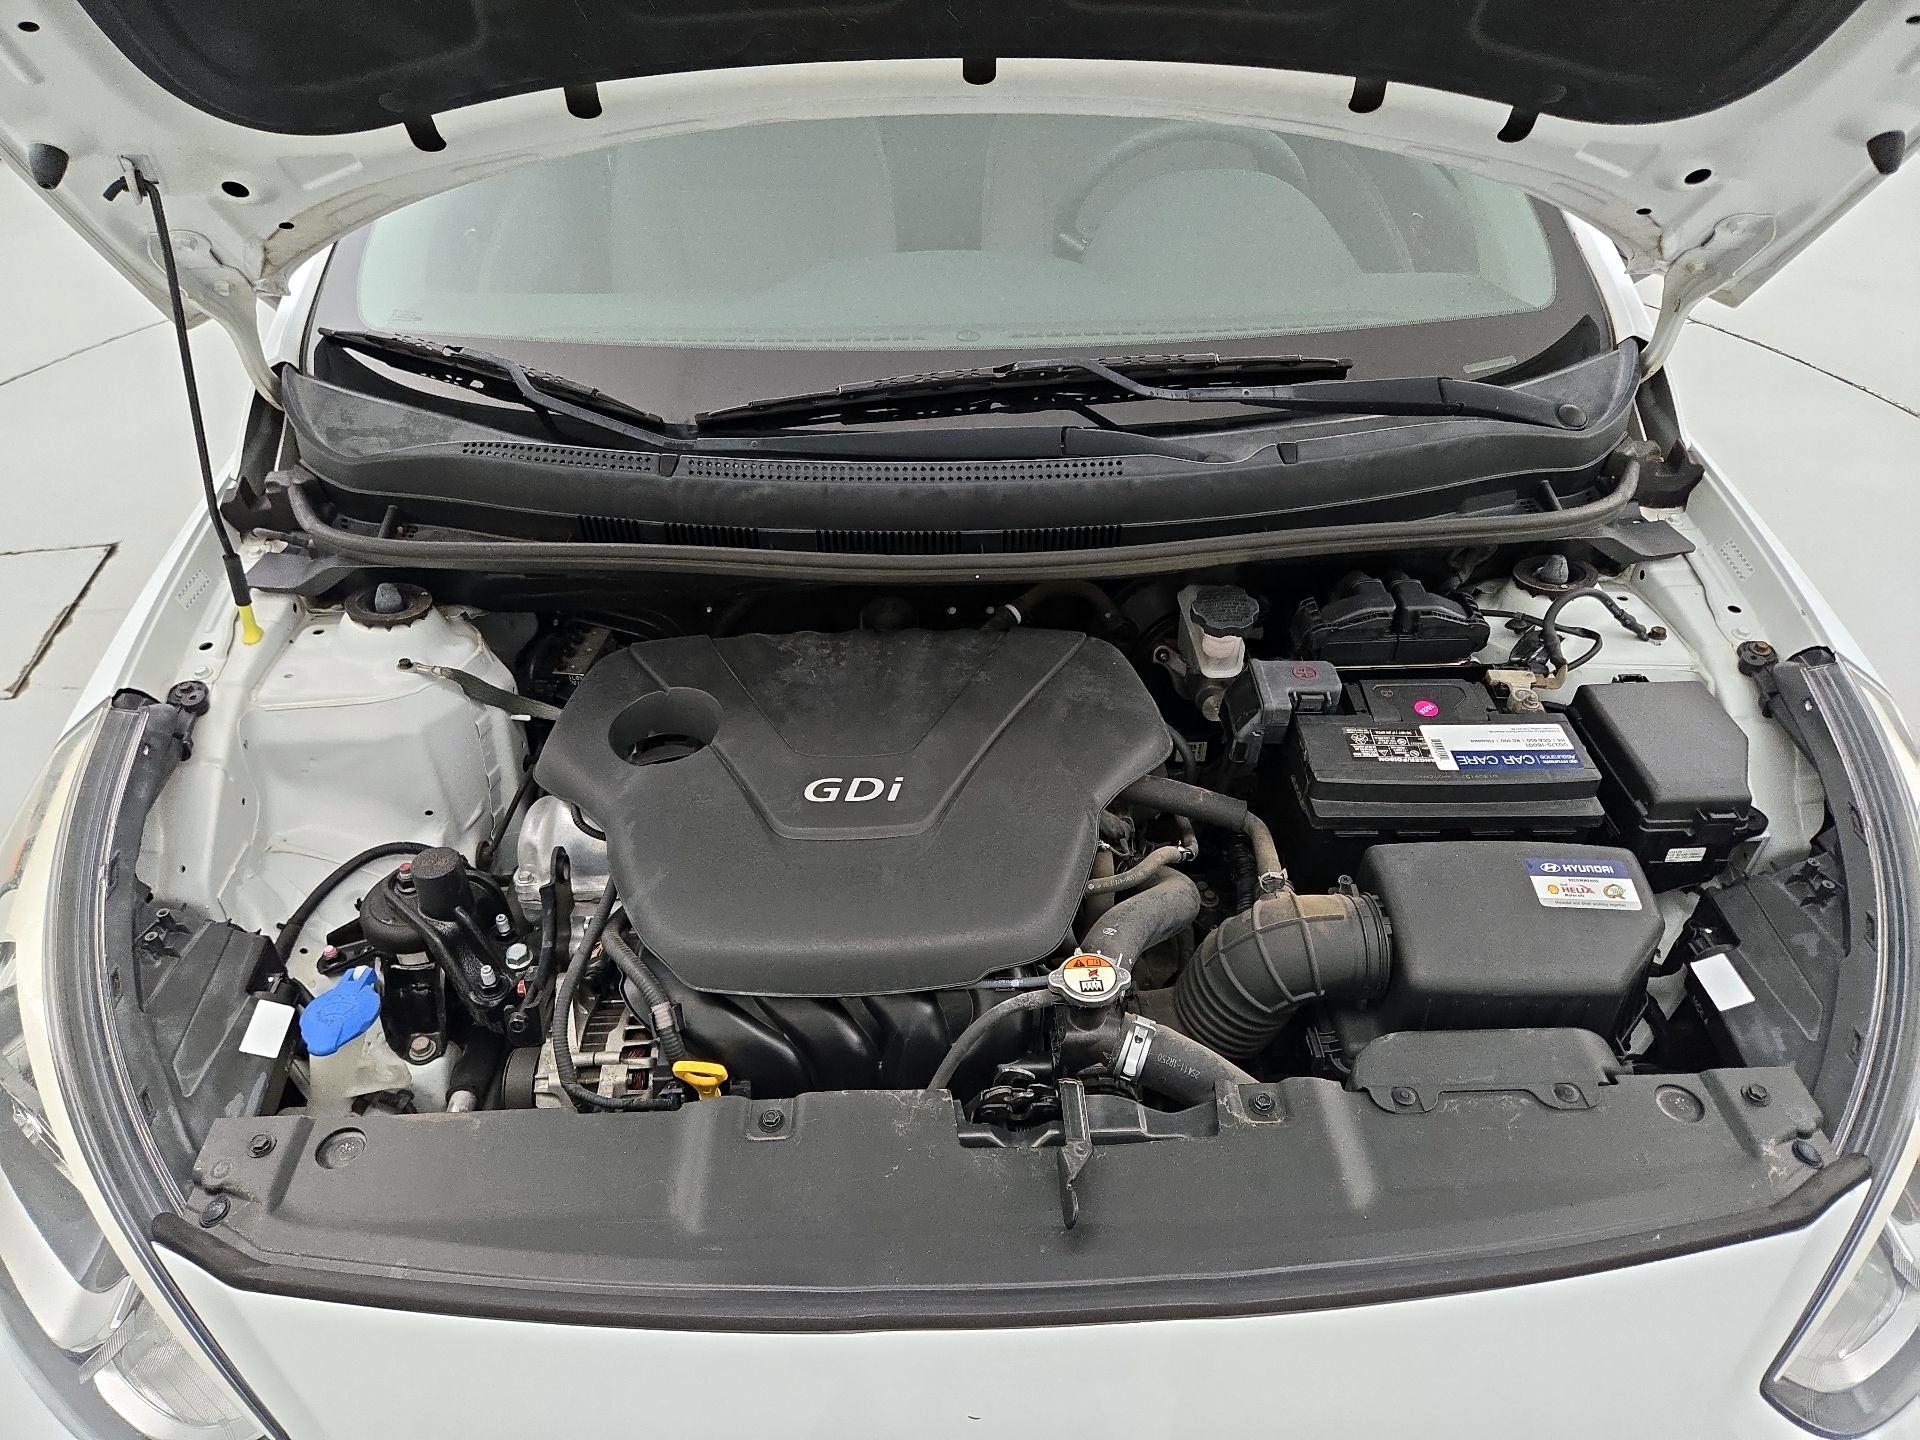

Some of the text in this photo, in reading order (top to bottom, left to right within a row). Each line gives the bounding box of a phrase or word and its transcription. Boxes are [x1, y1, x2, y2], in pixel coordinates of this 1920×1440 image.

[1456, 754, 1536, 765] CAR CARE
[804, 776, 904, 802] GDi
[1562, 864, 1615, 874] HYUNDAI
[1561, 885, 1596, 894] HELIX
